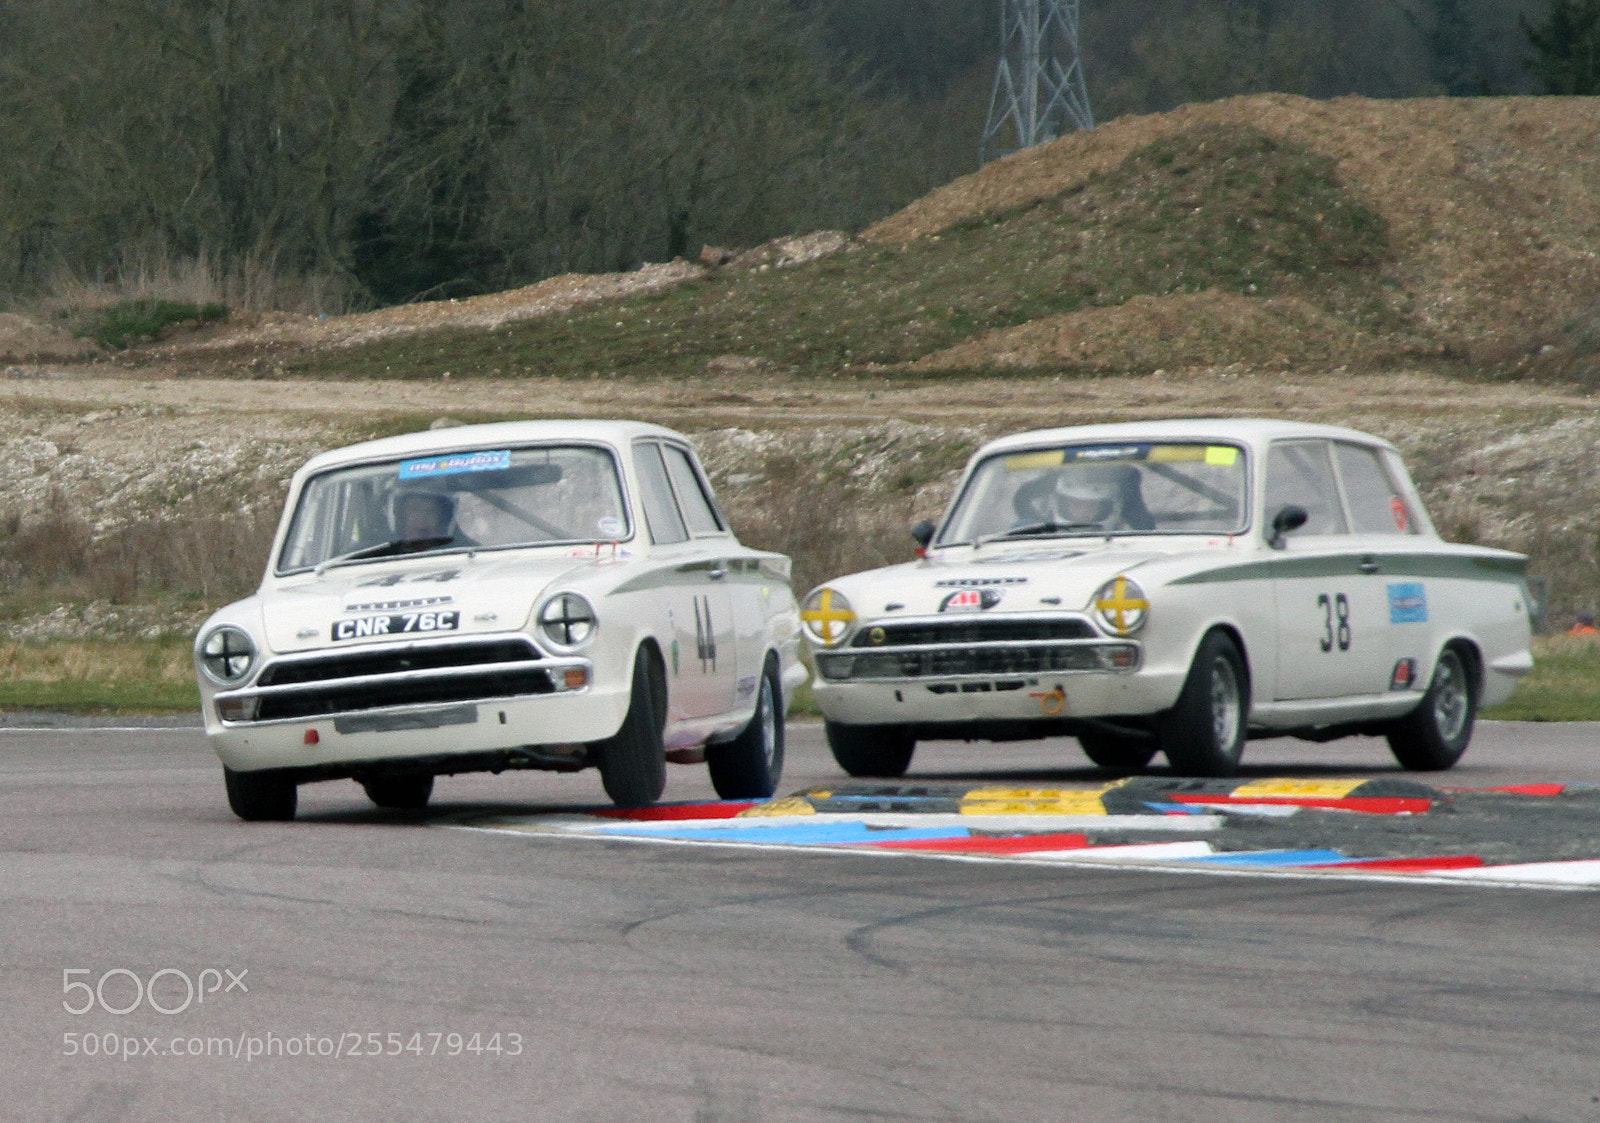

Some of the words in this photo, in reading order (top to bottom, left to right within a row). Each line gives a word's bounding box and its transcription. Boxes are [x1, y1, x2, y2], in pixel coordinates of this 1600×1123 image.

[337, 615, 391, 640] CNR
[402, 611, 455, 633] 76C
[1318, 592, 1351, 653] 38
